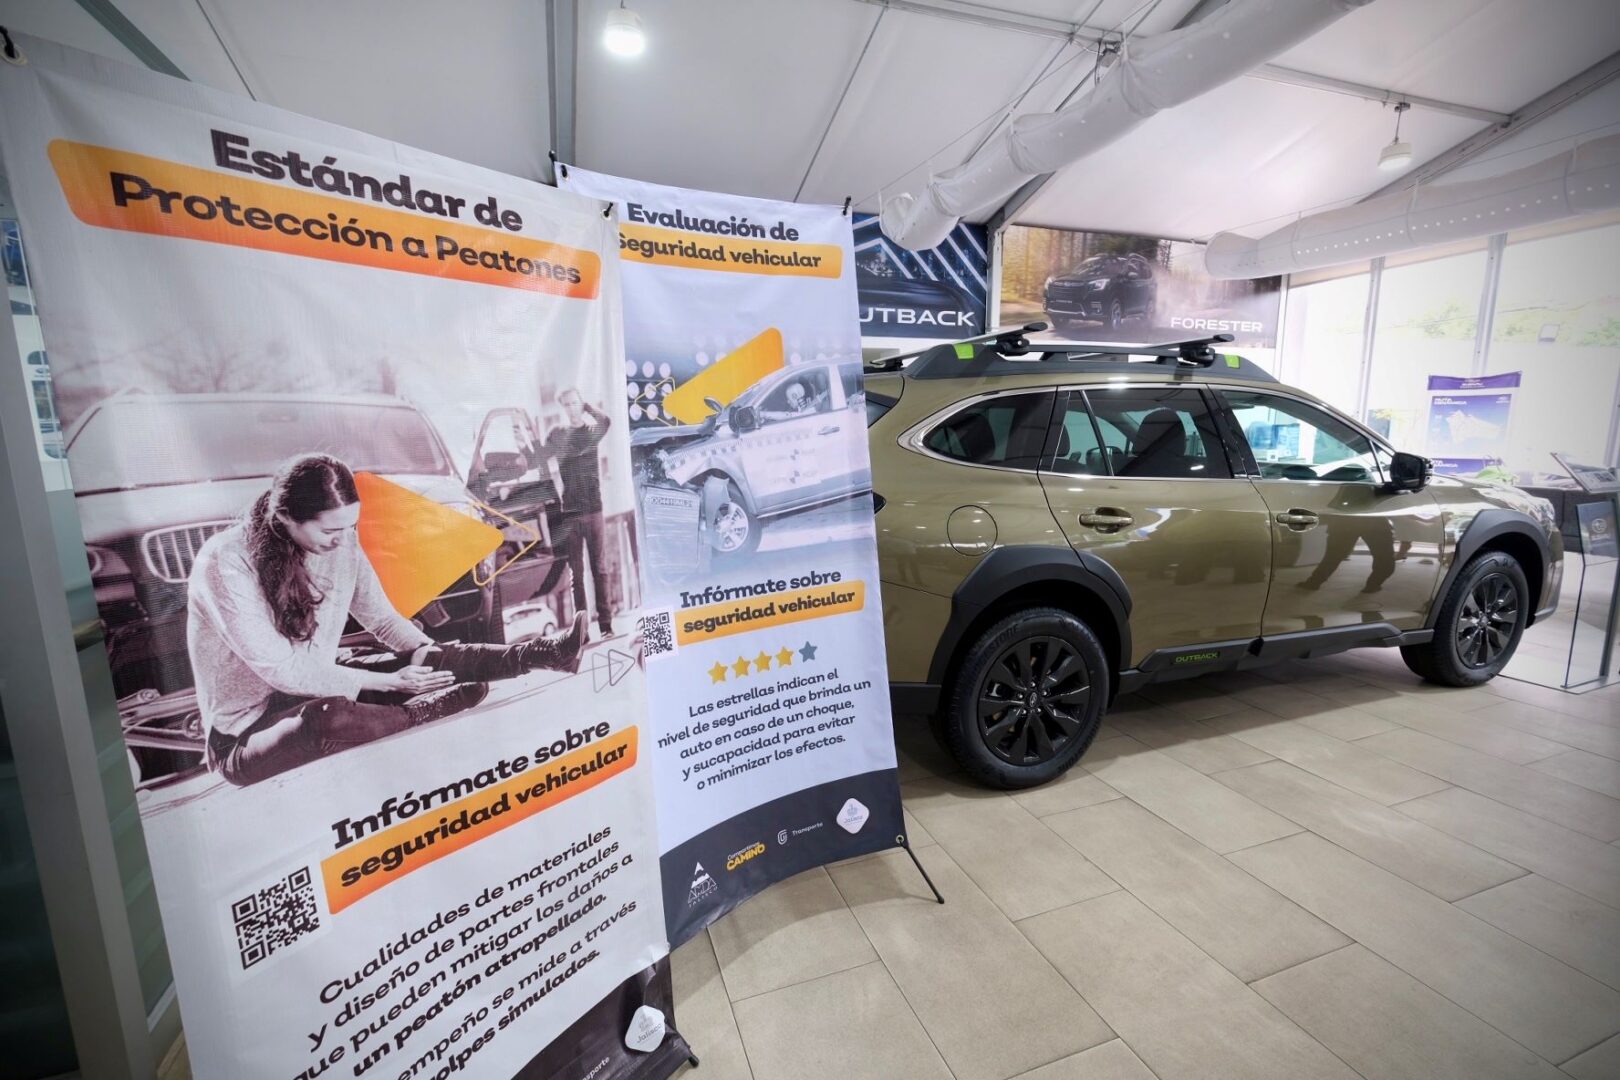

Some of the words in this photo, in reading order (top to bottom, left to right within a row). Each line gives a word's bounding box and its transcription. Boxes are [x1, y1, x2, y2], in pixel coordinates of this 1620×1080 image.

[210, 129, 465, 219] Estándar
[474, 197, 523, 232] de
[110, 171, 393, 252] Protección
[401, 237, 429, 259] a
[437, 234, 581, 284] Peatones
[627, 202, 766, 239] Evaluación
[769, 221, 799, 241] de
[729, 246, 821, 268] vehicular
[1170, 317, 1264, 332] FORESTER
[680, 578, 787, 609] Infórmate
[790, 571, 841, 591] sobre
[683, 601, 776, 633] seguridad
[779, 591, 855, 615] vehicular
[657, 726, 690, 748] nivel
[692, 721, 710, 735] de
[712, 699, 781, 727] seguridad
[783, 695, 806, 709] que
[809, 684, 852, 702] brinda
[853, 680, 871, 691] un
[689, 702, 714, 718] Las
[716, 686, 775, 709] estrellas
[777, 674, 825, 693] indican
[827, 668, 839, 680] el
[680, 740, 713, 759] auto
[715, 733, 731, 746] en
[734, 723, 765, 739] caso
[768, 717, 784, 729] de
[787, 712, 804, 723] un
[806, 700, 854, 718] choque,
[682, 767, 691, 782] y
[783, 725, 815, 744] para
[818, 715, 855, 731] evitar
[697, 780, 706, 790] o
[707, 755, 773, 786] minimizar
[775, 748, 793, 761] los
[795, 734, 846, 754] efectos.
[332, 756, 529, 849] Infórmate
[534, 721, 610, 764] sobre
[341, 793, 511, 887] seguridad
[515, 744, 628, 804] vehicular
[726, 843, 765, 871] CAMINO
[792, 822, 823, 836] Transporte
[308, 1023, 327, 1053] y
[334, 961, 420, 1027] diseño
[424, 938, 455, 964] de
[459, 894, 534, 947] partes
[537, 841, 619, 898] frontales
[320, 903, 470, 1004] Cualidades
[475, 886, 504, 908] de
[508, 826, 611, 891] materiales
[350, 970, 446, 1053] pueden
[450, 917, 532, 974] mitigar
[536, 900, 564, 922] los
[567, 862, 618, 903] daños
[621, 853, 633, 867] a
[353, 1042, 390, 1077] un
[393, 972, 482, 1050] peatón
[485, 894, 607, 977] atropellado.
[492, 986, 515, 1010] se
[518, 951, 567, 990] mide
[570, 941, 582, 954] a
[584, 901, 637, 943] través
[430, 1027, 496, 1080] olpes
[498, 950, 600, 1030] simulados.
